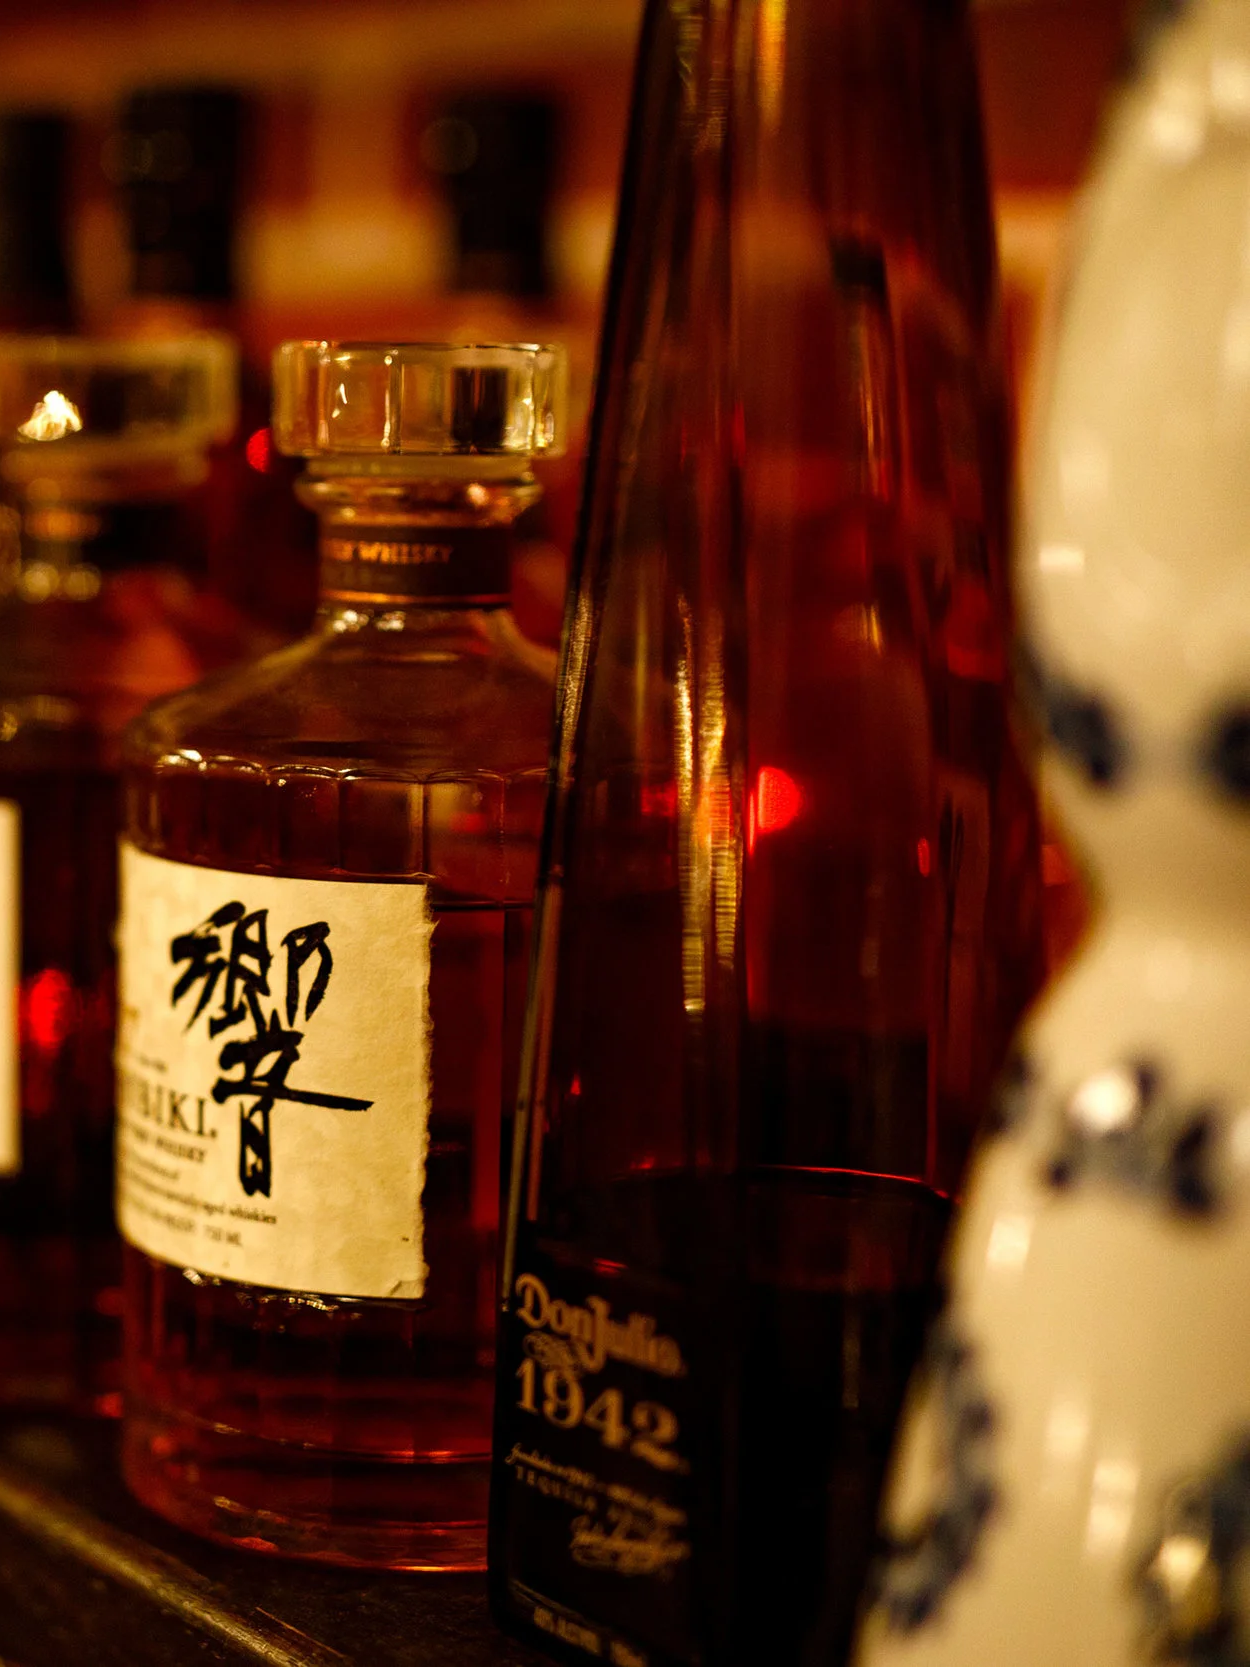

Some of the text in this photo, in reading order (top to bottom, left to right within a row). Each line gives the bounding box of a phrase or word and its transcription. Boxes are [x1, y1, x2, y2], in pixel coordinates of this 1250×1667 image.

[357, 540, 452, 565] WHISKY
[170, 900, 374, 1199] 響
[515, 1272, 592, 1343] Don
[515, 1358, 691, 1475] 1942
